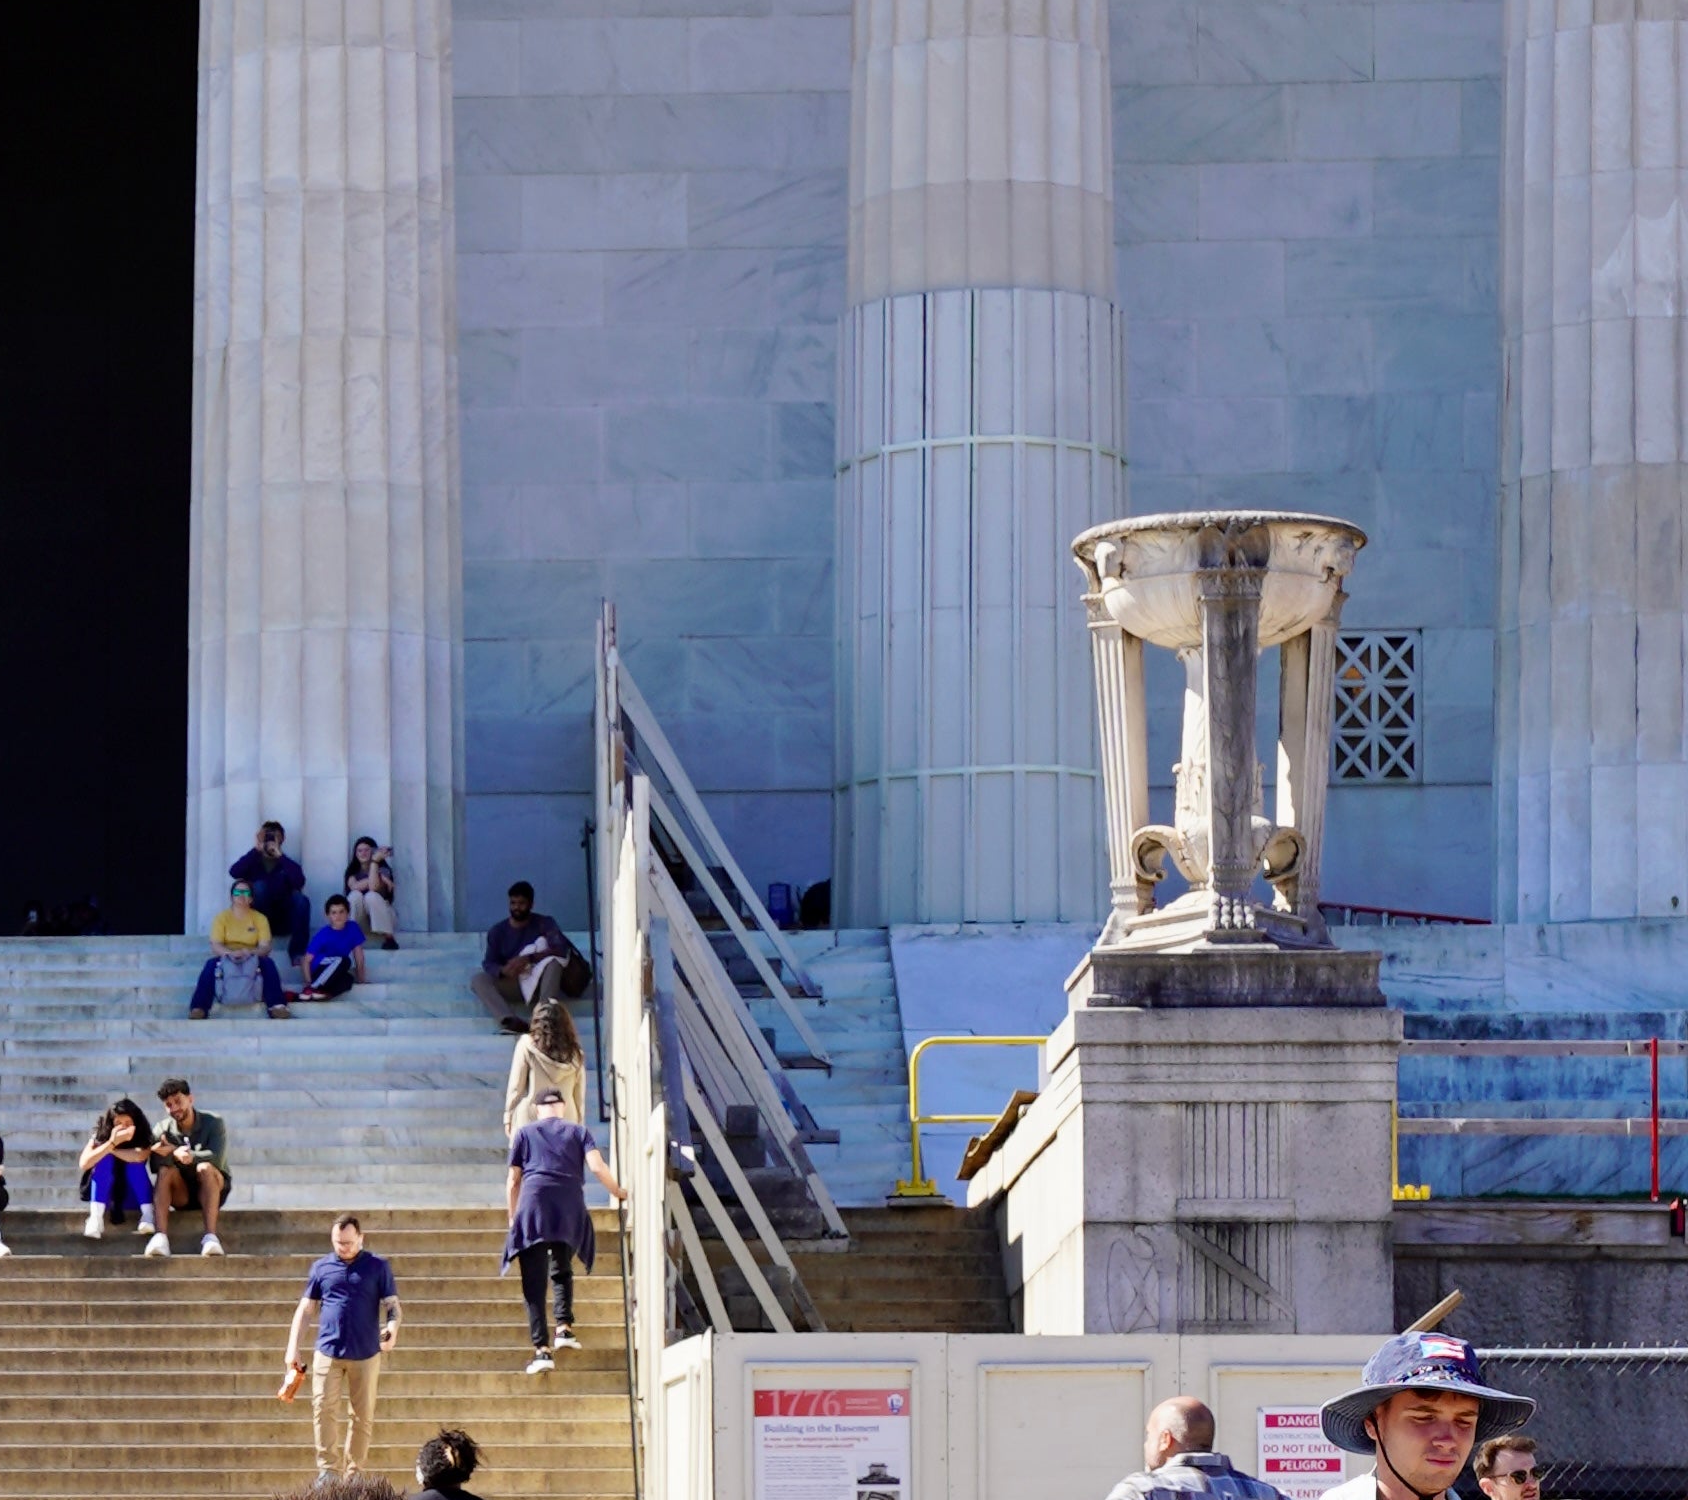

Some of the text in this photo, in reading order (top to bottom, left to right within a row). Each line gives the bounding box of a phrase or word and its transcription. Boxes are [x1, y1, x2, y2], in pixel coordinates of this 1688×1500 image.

[768, 1390, 841, 1417] 1776
[1277, 1415, 1321, 1426] DANGE
[764, 1424, 804, 1434] Building
[817, 1424, 832, 1432] the
[835, 1424, 880, 1432] Basement
[1263, 1444, 1340, 1453] DO NOT ENTER
[1279, 1459, 1328, 1471] PELIGRO
